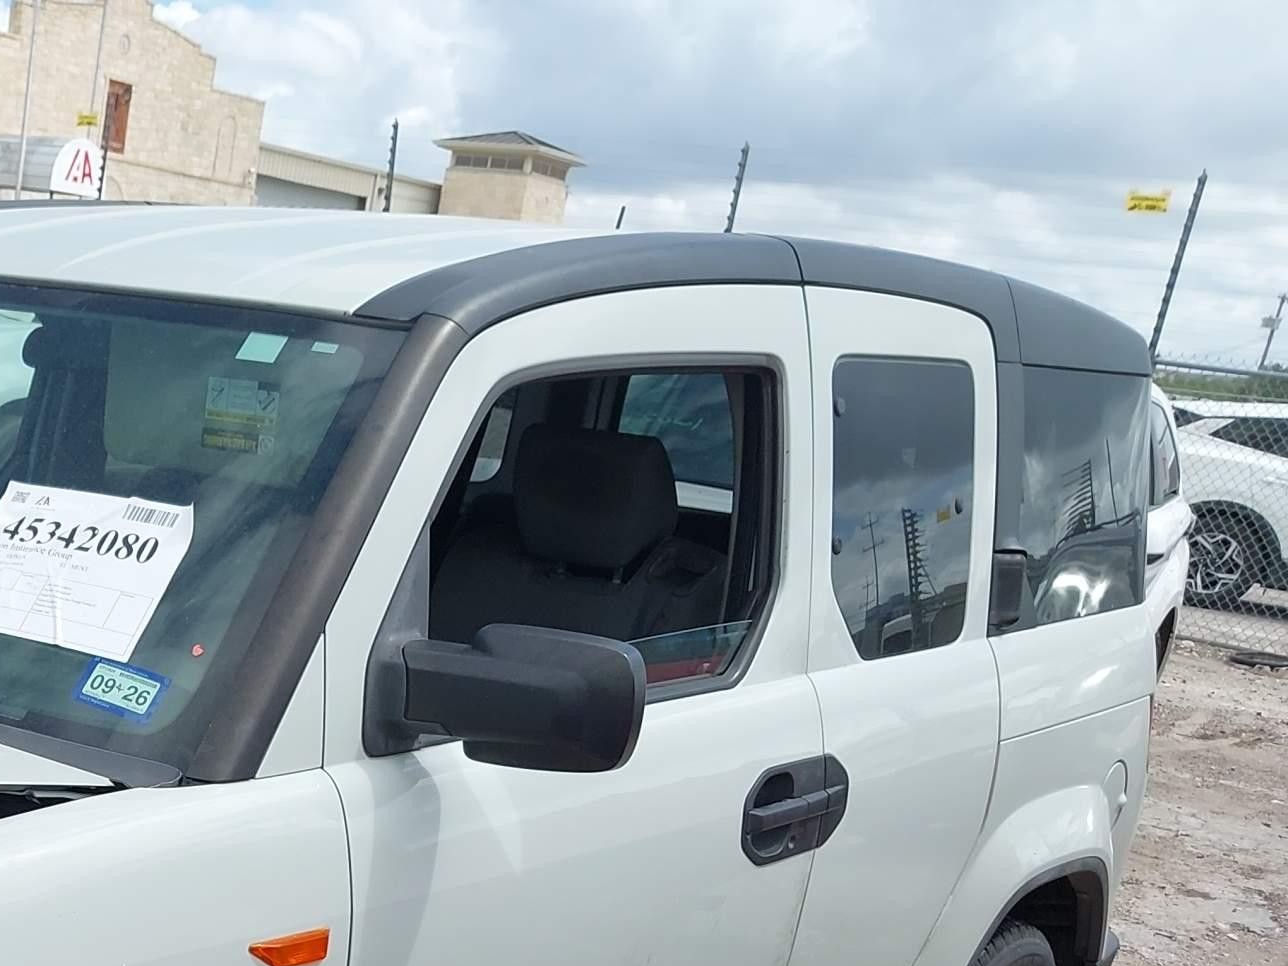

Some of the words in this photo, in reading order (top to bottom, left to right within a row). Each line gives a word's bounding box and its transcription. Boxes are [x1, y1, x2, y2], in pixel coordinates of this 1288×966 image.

[2, 515, 159, 564] 45342080
[47, 548, 73, 560] Group
[90, 674, 116, 694] 09
[121, 685, 151, 706] 26
